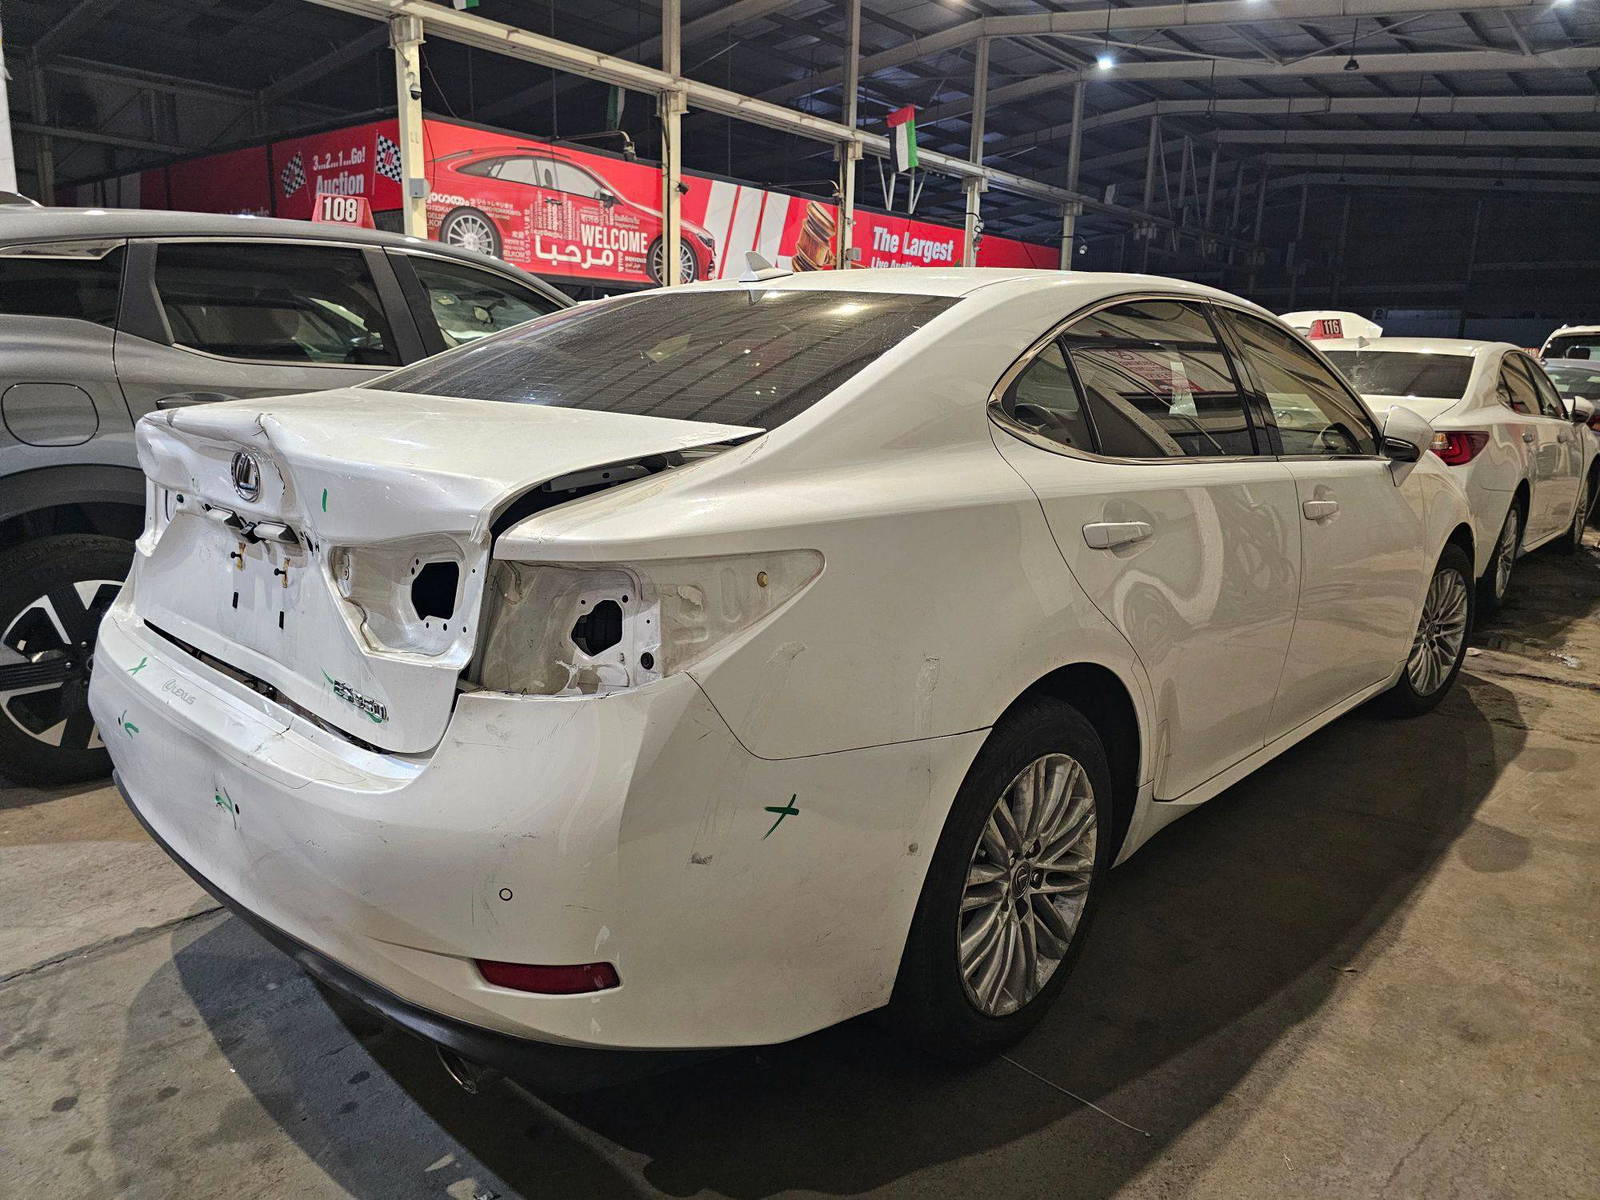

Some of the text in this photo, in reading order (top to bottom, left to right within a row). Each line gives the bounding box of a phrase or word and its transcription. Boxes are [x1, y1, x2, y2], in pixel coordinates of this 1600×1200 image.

[316, 171, 364, 197] Auction
[324, 196, 358, 222] 108
[535, 234, 615, 269] مرحبا
[581, 223, 649, 254] WELCOME
[873, 226, 953, 263] The Largest
[1323, 320, 1339, 334] 116
